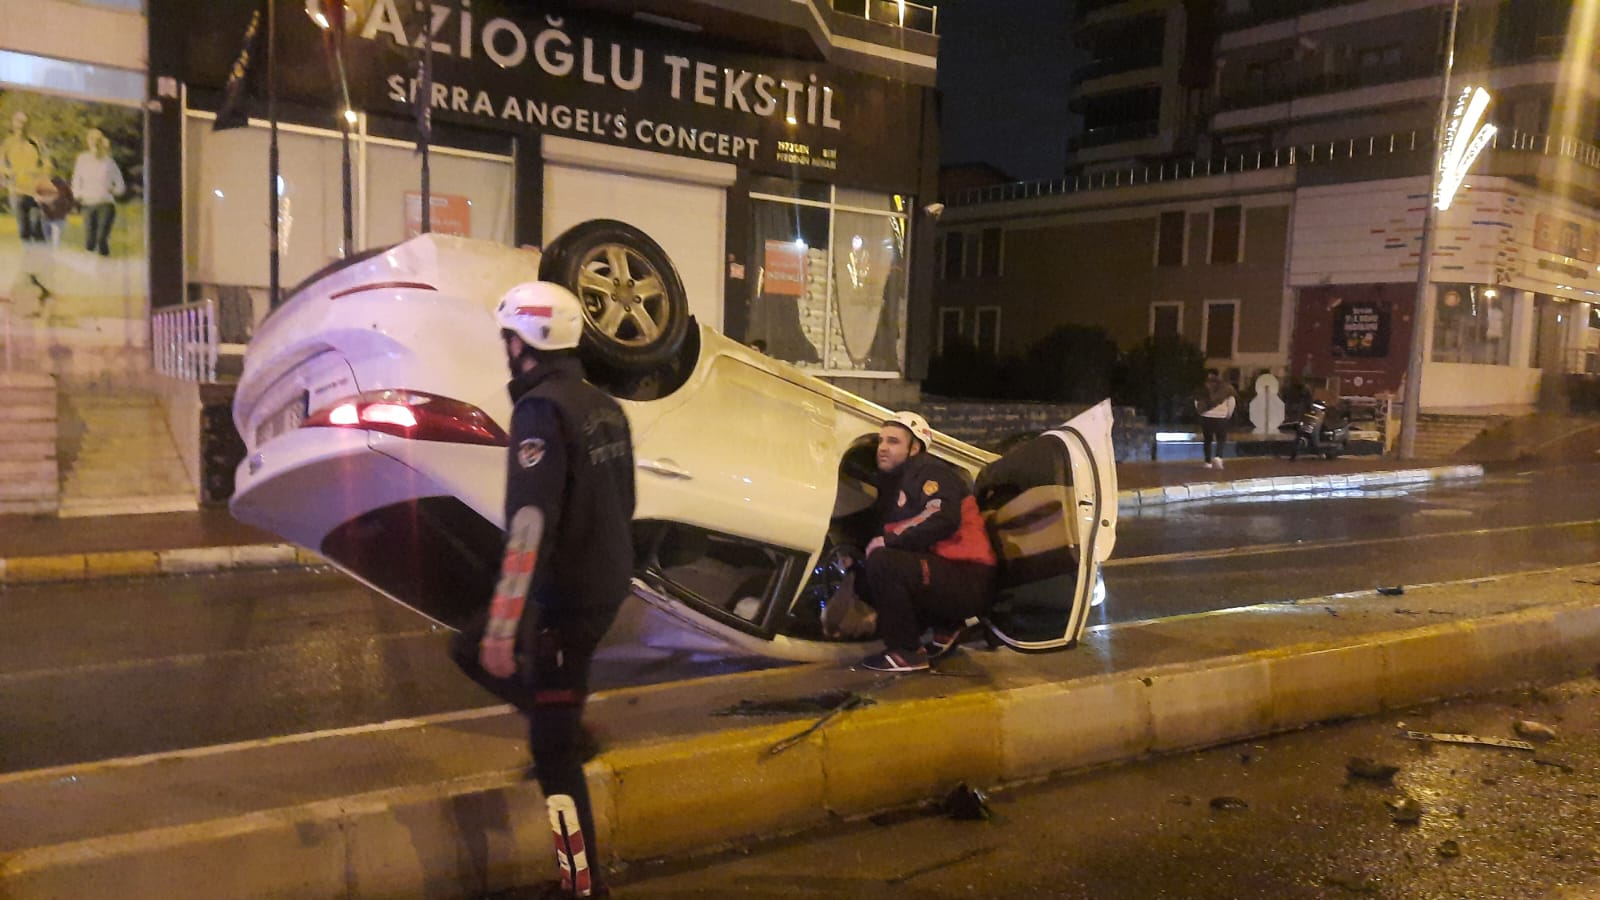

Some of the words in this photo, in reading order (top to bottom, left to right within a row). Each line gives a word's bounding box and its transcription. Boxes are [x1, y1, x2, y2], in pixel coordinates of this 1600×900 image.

[664, 54, 842, 130] TEKSTİL
[502, 96, 628, 139] ANGEL'S
[635, 119, 760, 161] CONCEPT
